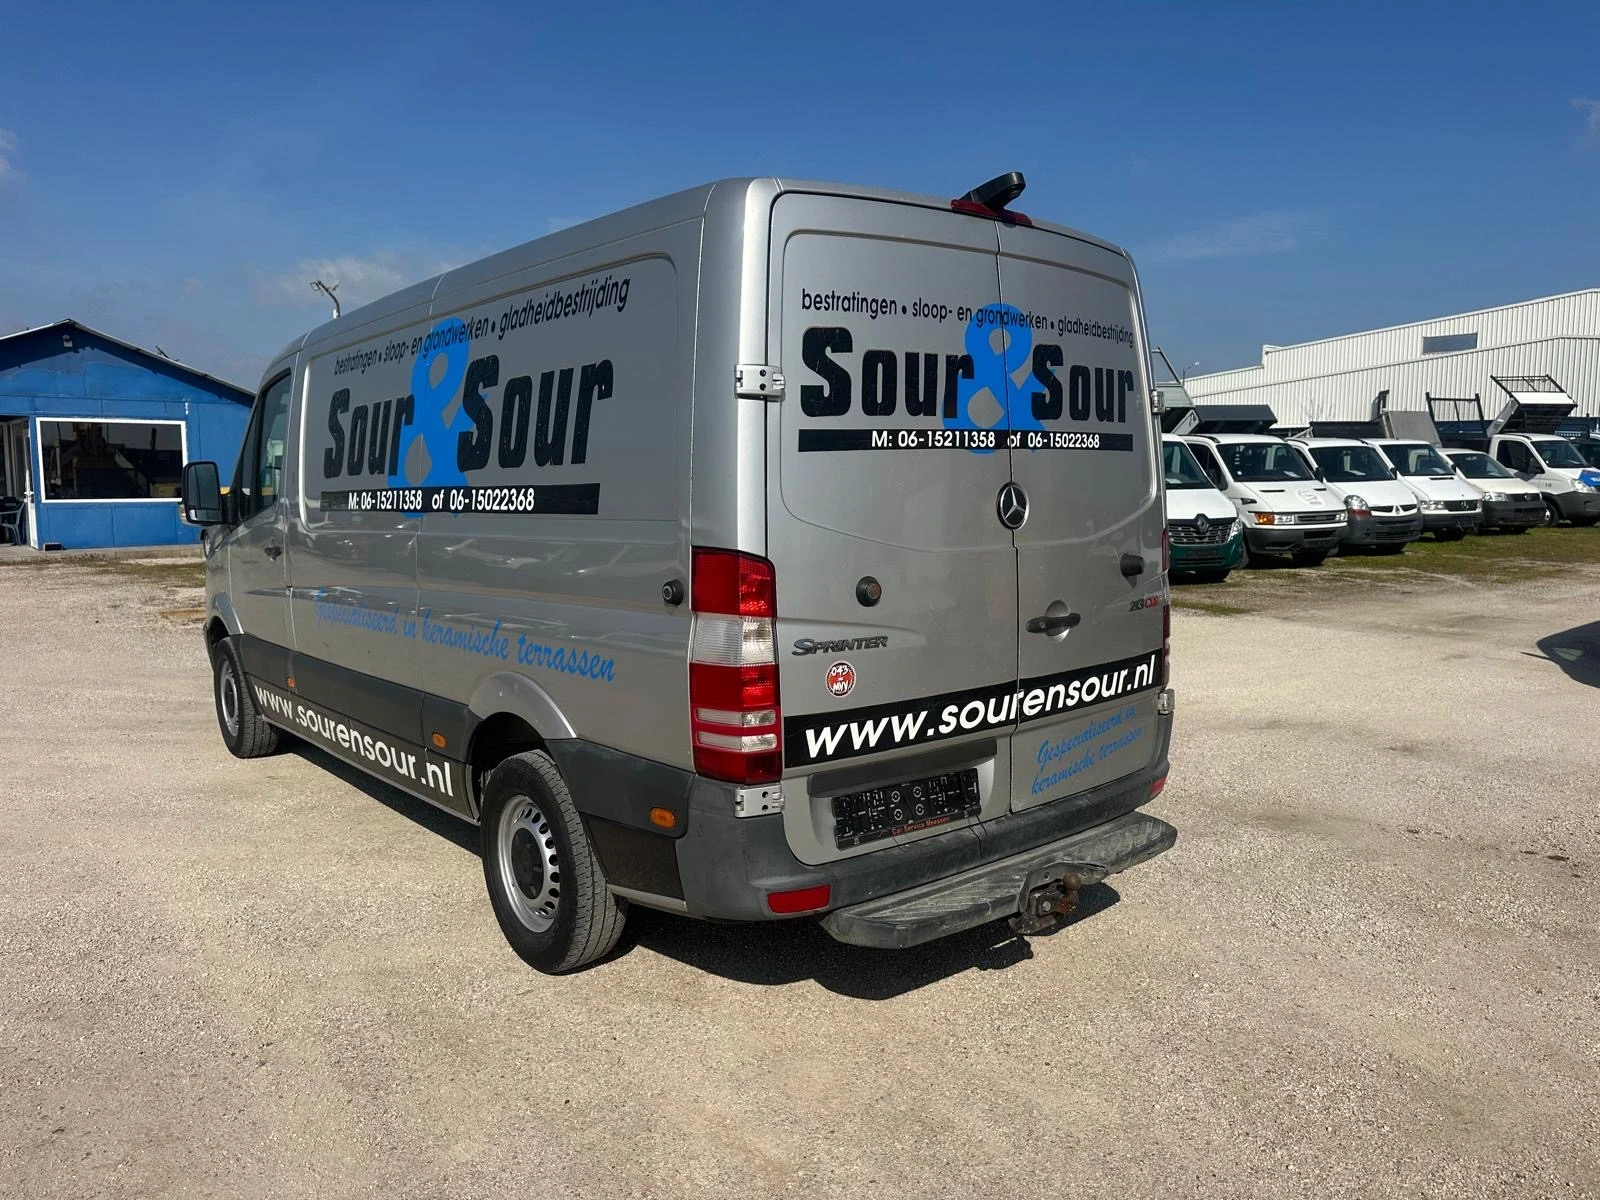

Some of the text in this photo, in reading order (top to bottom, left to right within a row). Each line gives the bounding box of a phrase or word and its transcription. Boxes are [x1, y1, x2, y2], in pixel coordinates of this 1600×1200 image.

[334, 348, 377, 376] bestratingen
[411, 336, 422, 356] en
[423, 316, 488, 359] grondwerken
[499, 276, 631, 340] gladheidbestrijding
[801, 288, 1134, 347] bestratingen sloop- en grondwerken gladheidbestrijding
[800, 326, 975, 418] Sour
[1031, 344, 1135, 423] Sour
[323, 387, 416, 479] Sour
[457, 354, 614, 473] Sour
[872, 430, 1100, 449] M: 06-15211358 of 06-15022368
[348, 488, 535, 511] M: 06-15211358 of 06-15022368
[423, 608, 509, 660] keramische
[517, 632, 616, 682] terrassen
[791, 635, 888, 656] SPRINTER
[832, 664, 849, 676] 043
[254, 684, 455, 798] www.sourensour.nl
[805, 654, 1157, 759] www.sourensour.nl
